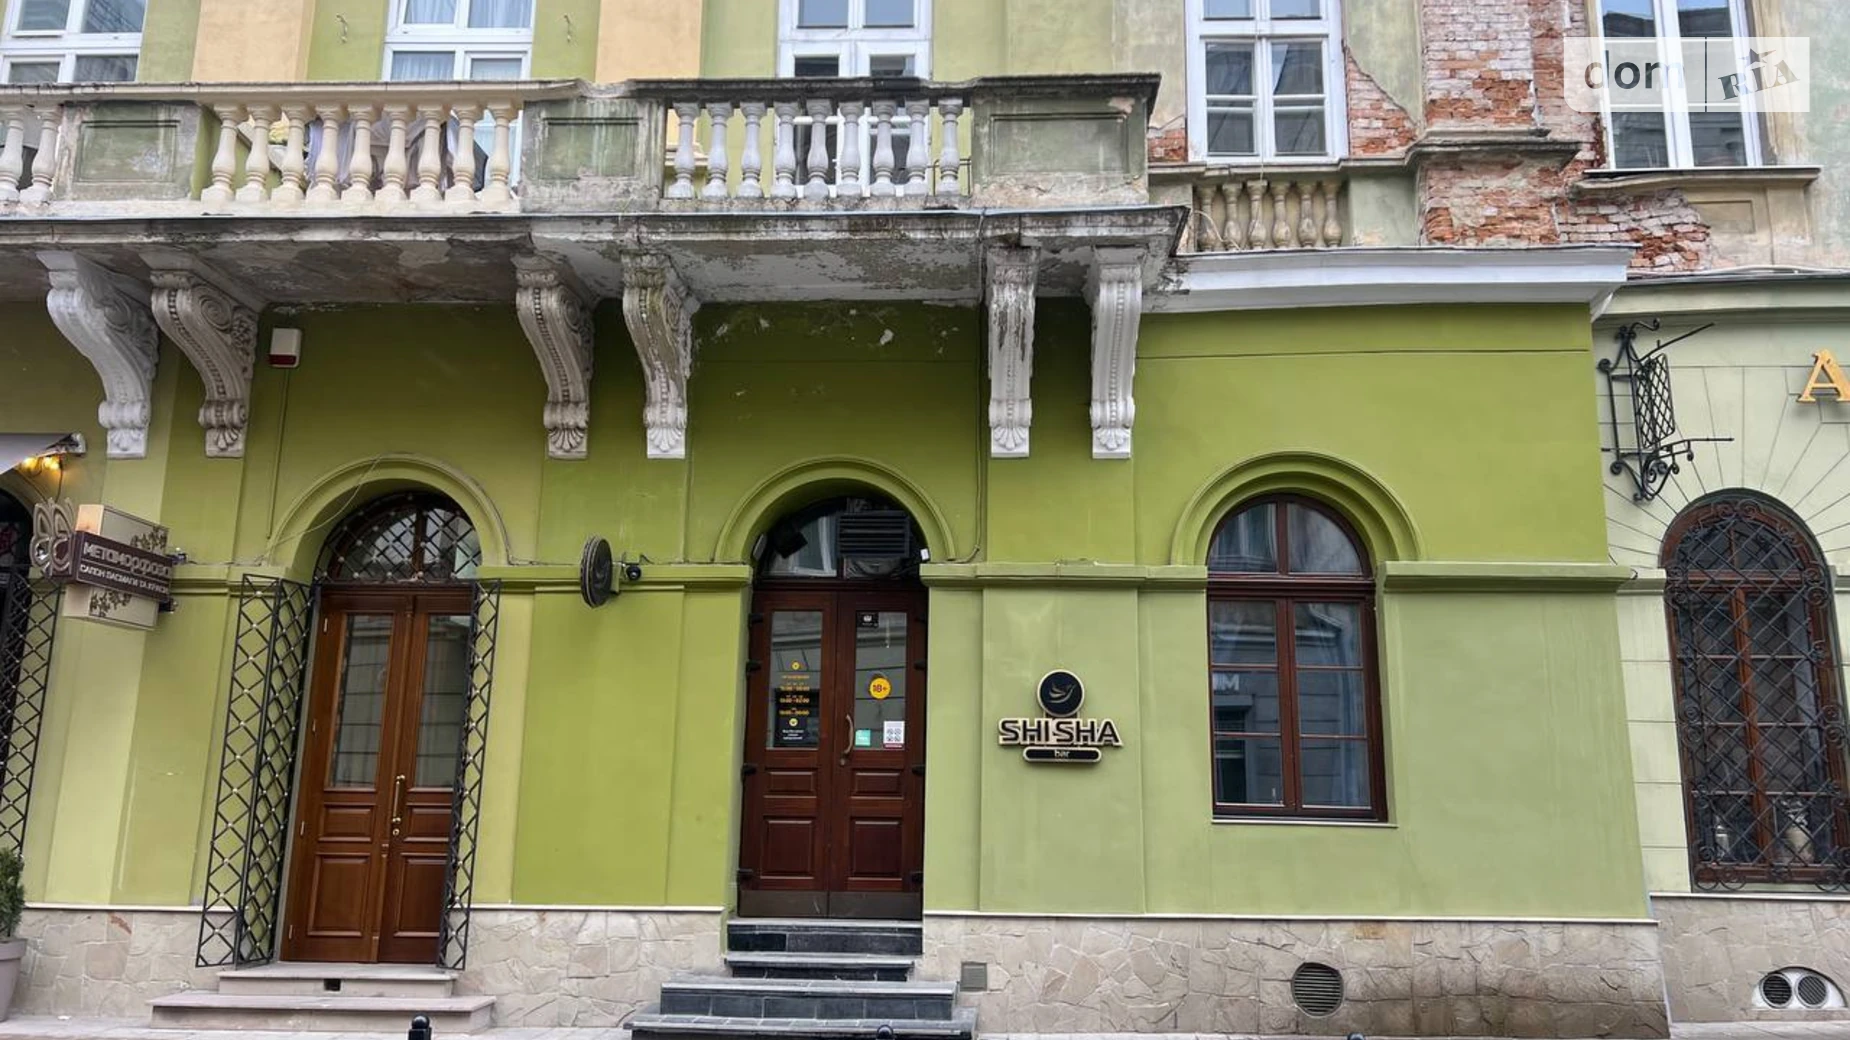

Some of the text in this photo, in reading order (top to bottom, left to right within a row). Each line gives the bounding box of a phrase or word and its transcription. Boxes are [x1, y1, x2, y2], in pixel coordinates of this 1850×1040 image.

[872, 684, 888, 693] 18+
[999, 718, 1122, 746] SHISHA
[1054, 748, 1070, 757] bar
